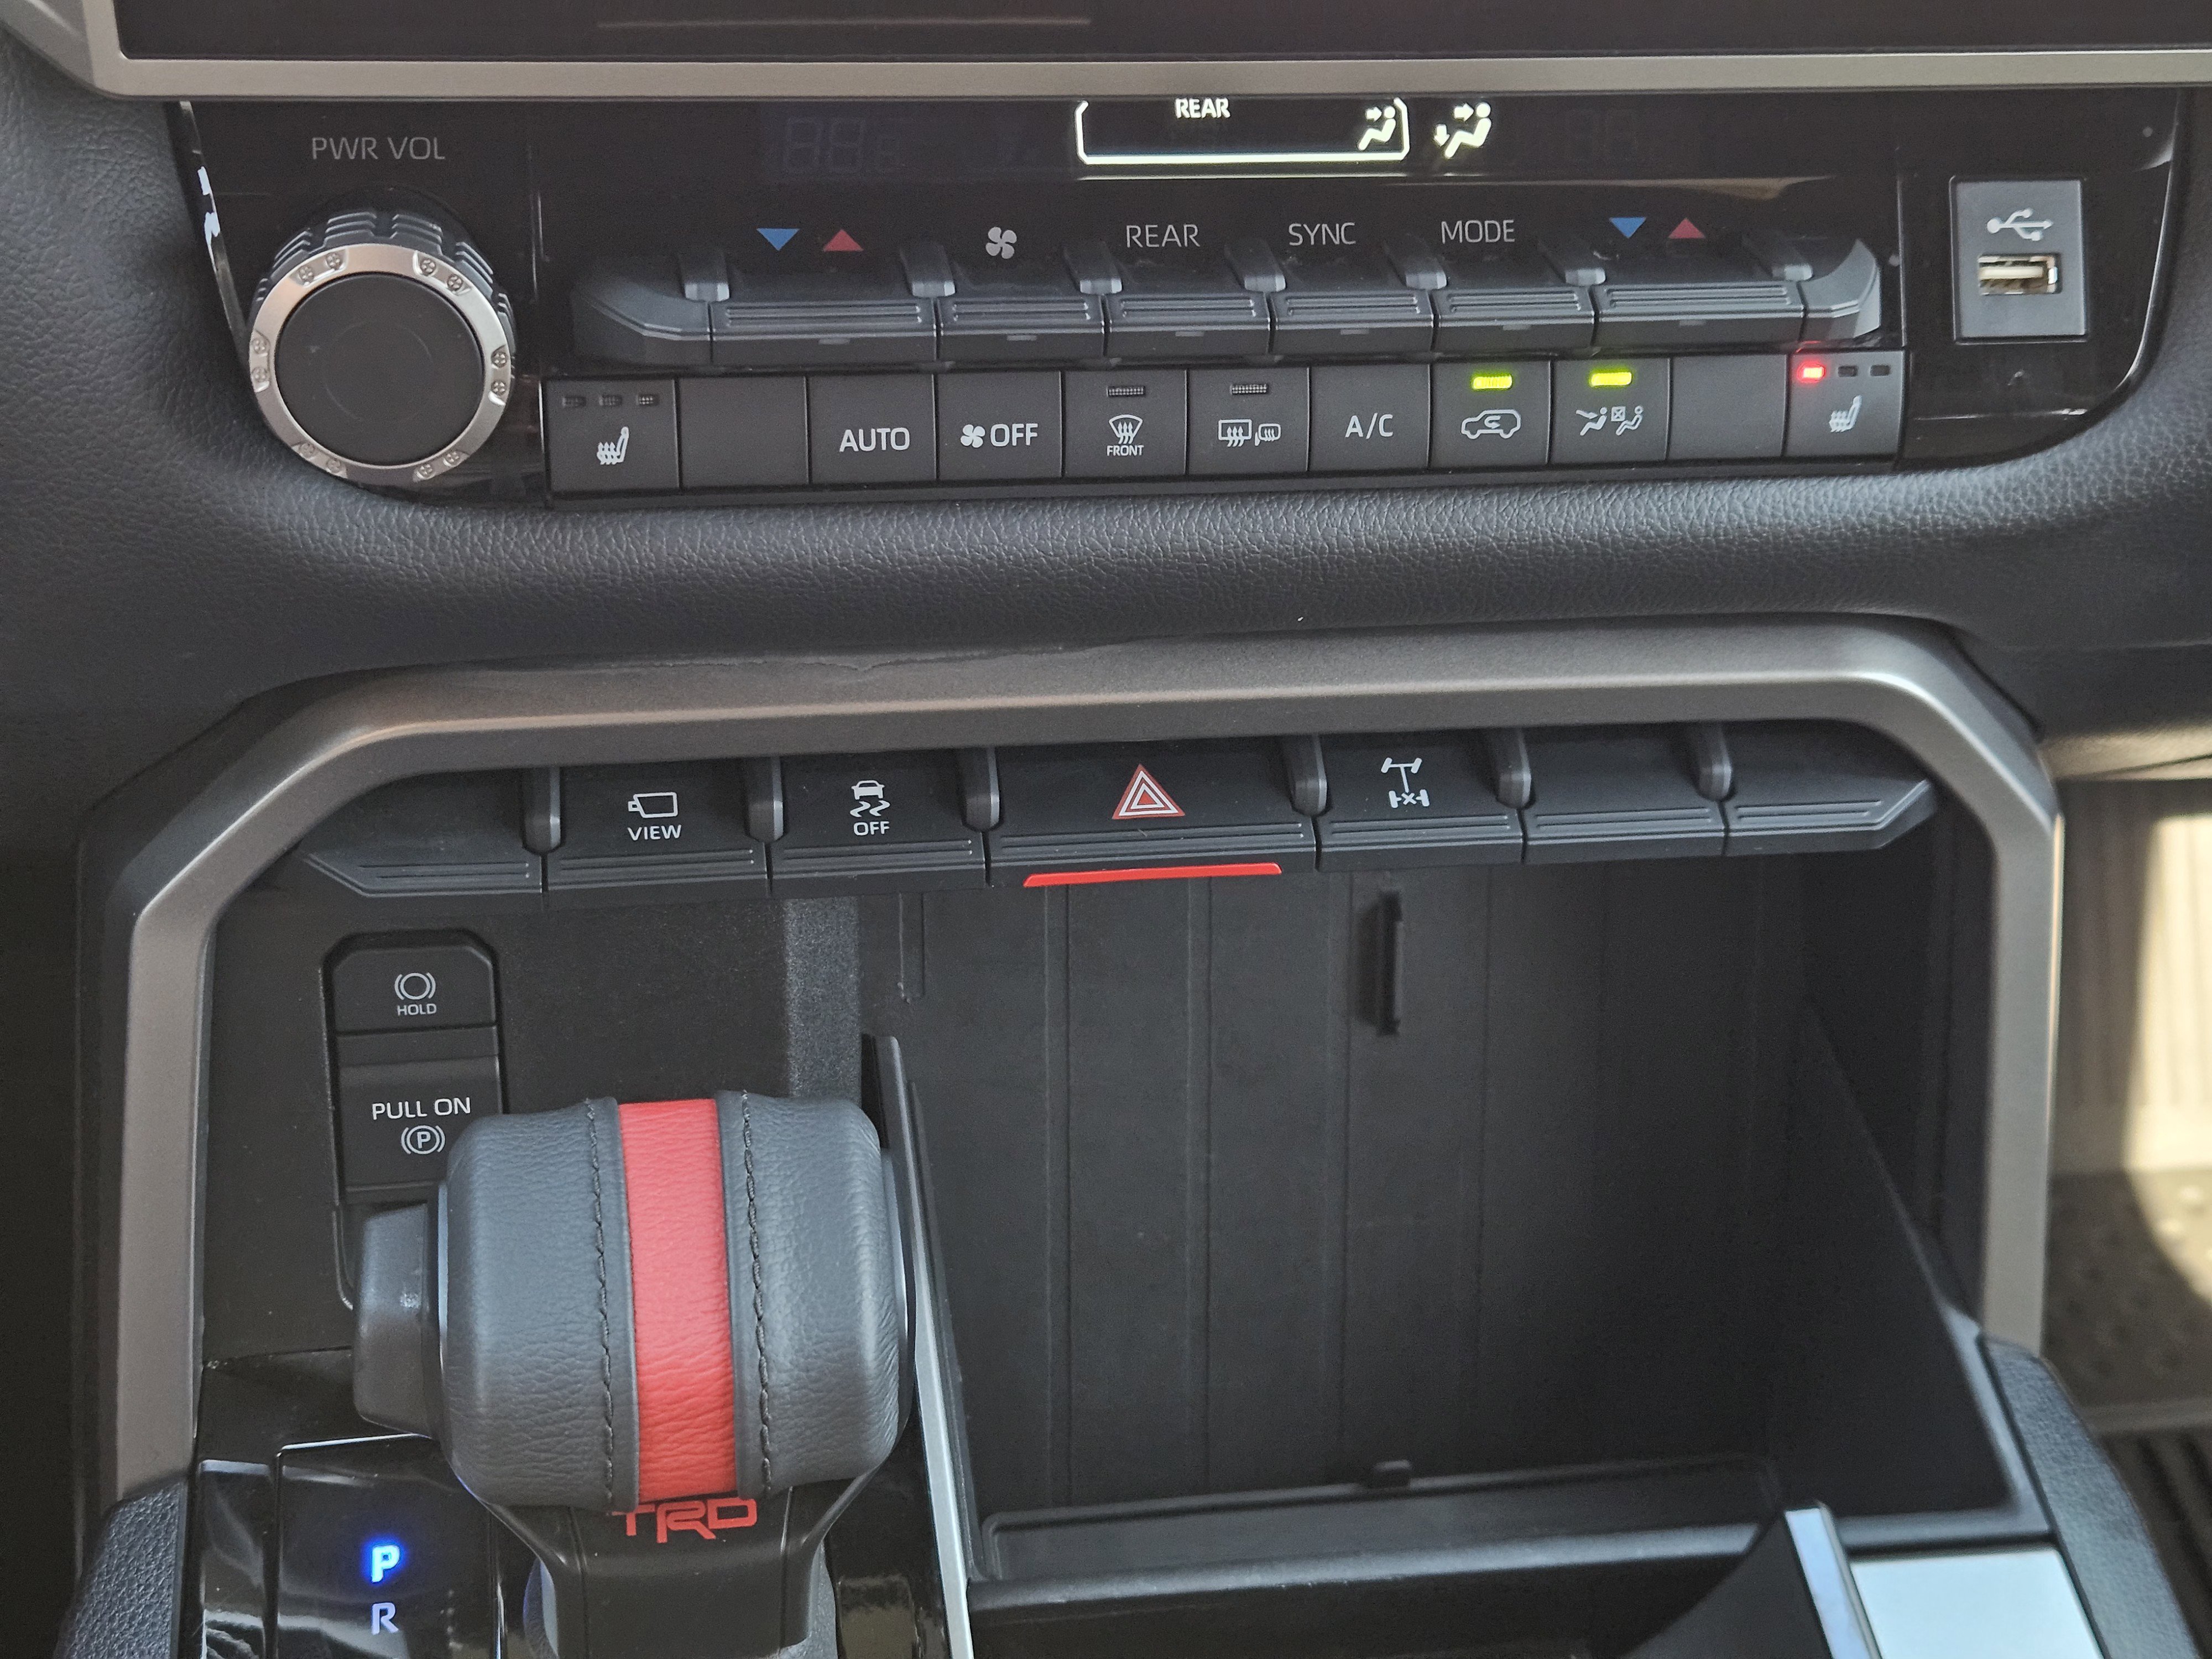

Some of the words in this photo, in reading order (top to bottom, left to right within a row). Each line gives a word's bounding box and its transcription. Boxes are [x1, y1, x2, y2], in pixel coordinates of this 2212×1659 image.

[1175, 97, 1230, 118] REAR
[312, 137, 378, 160] PWR
[387, 137, 446, 160] VOL
[1126, 224, 1200, 248] REAR
[1288, 222, 1356, 246] SYNC
[1441, 219, 1515, 244] MODE
[990, 423, 1038, 447] OFF
[1345, 413, 1393, 439] A/C
[839, 427, 910, 452] AUTO
[1107, 445, 1144, 456] FRONT
[627, 825, 682, 841] VIEW
[853, 821, 890, 836] OFF
[397, 1003, 437, 1016] HOLD
[372, 1100, 427, 1120] PULL
[434, 1097, 471, 1116] ON
[416, 1131, 431, 1149] P
[612, 1497, 758, 1543] TRD
[372, 1545, 400, 1583] P
[372, 1602, 399, 1636] R
